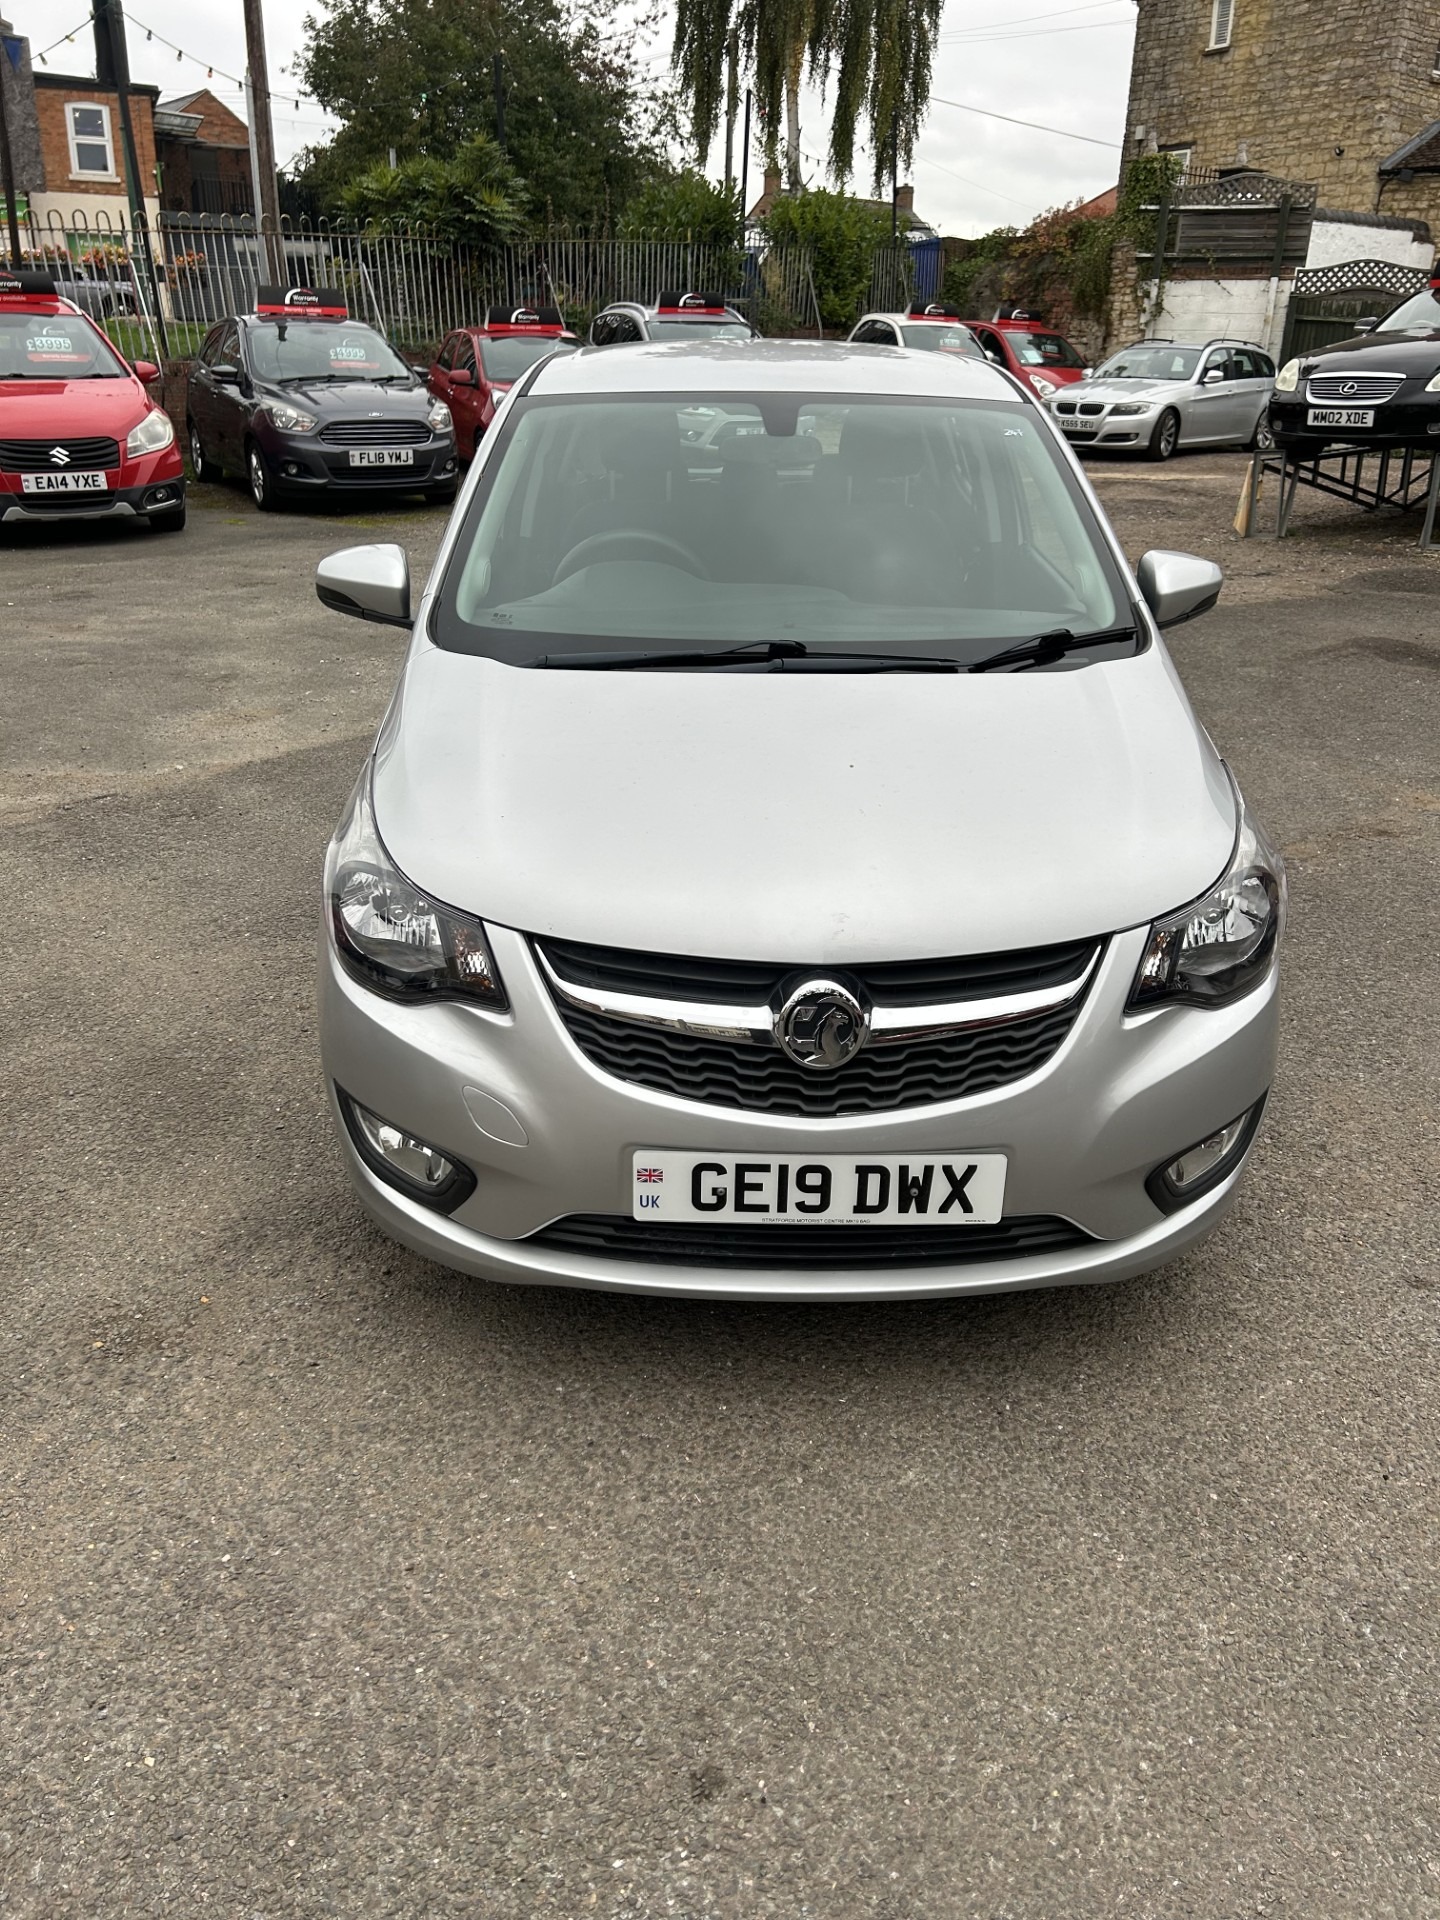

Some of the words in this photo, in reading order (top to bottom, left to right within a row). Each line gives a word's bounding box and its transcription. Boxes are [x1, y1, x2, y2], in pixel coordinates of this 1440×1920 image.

[1312, 411, 1343, 424] MM02
[1345, 412, 1369, 425] XDE
[387, 451, 409, 463] YMJ
[71, 474, 101, 488] YXE
[852, 1164, 978, 1214] DWX
[639, 1194, 660, 1208] UK
